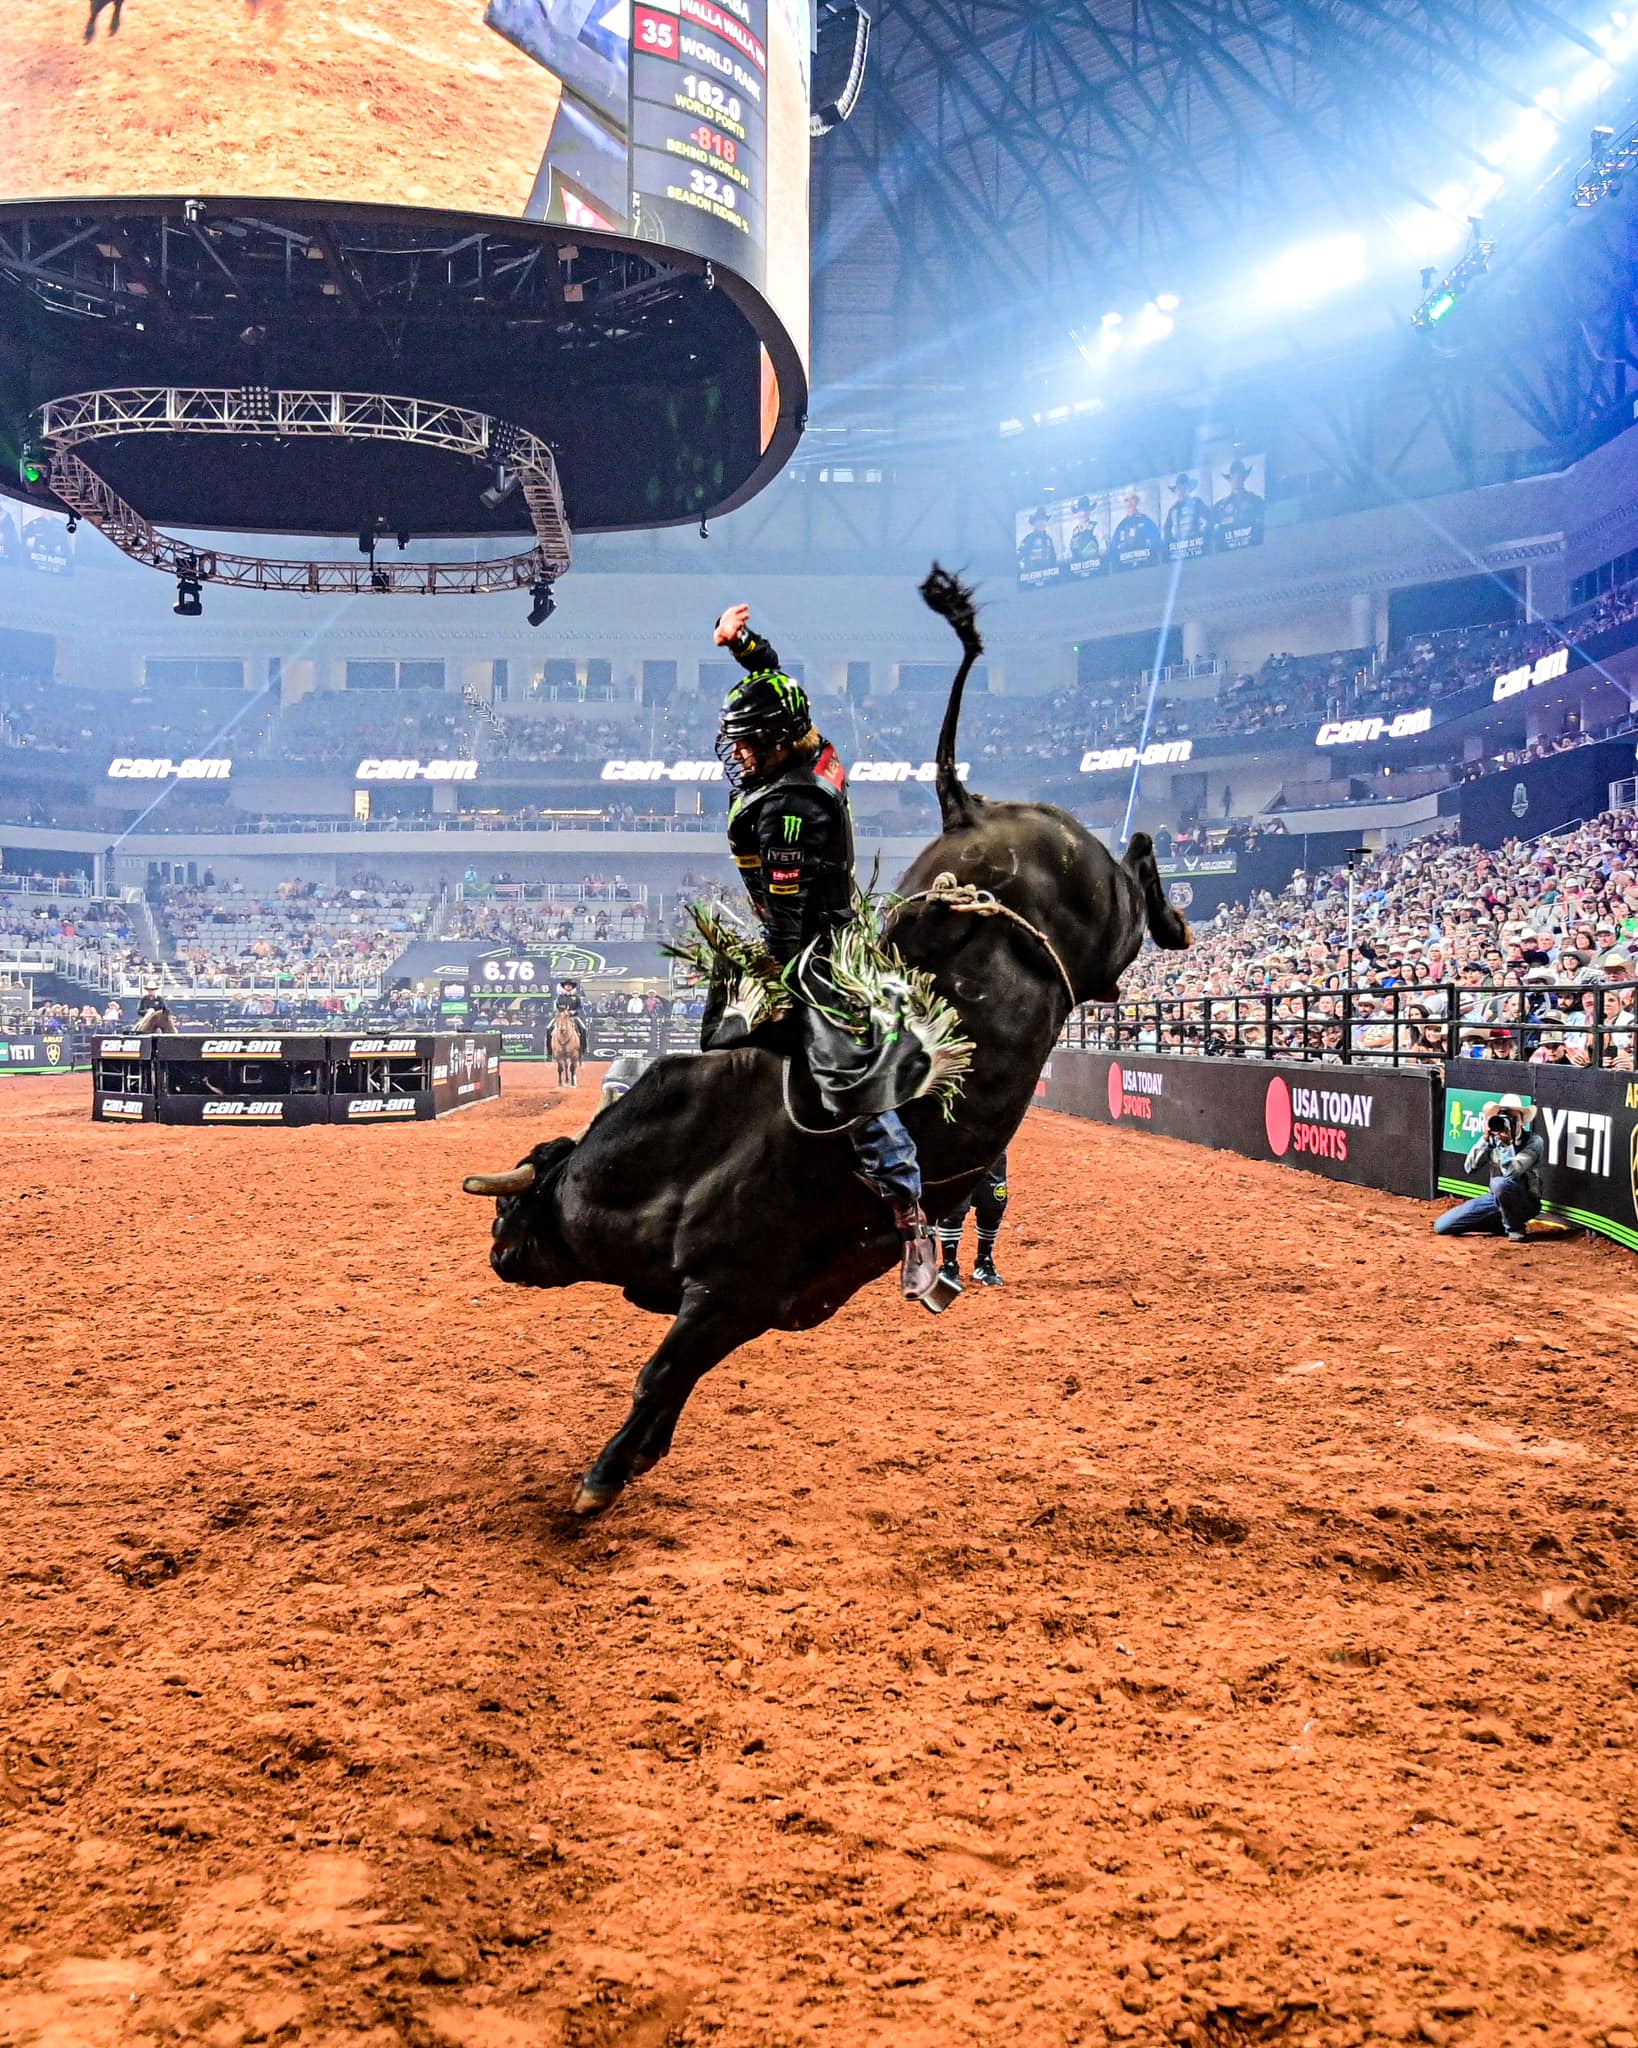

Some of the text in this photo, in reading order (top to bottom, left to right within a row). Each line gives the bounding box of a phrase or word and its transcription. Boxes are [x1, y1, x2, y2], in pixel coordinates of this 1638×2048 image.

[680, 0, 723, 29] WALLA
[641, 19, 673, 49] 35
[680, 35, 761, 102] WORLD RANK
[683, 75, 740, 121] 162.0
[675, 93, 745, 139] WORLD POINTS
[690, 126, 736, 163] -818
[666, 138, 708, 163] BEHIND
[708, 154, 740, 182] WORLD
[690, 168, 735, 209] 32.9
[667, 185, 712, 212] SEASON
[712, 203, 741, 228] RIDING
[1315, 708, 1432, 746] can-am
[107, 757, 232, 779] can-am
[355, 758, 480, 780] can-am
[1079, 739, 1192, 772] can-am
[601, 760, 725, 781] can-am
[771, 851, 801, 863] YETI
[484, 961, 535, 981] 6.76
[9, 1045, 35, 1060] YETI
[101, 1039, 141, 1052] can-am
[201, 1040, 282, 1053] can-am
[350, 1039, 416, 1053] can-am
[1122, 1069, 1163, 1096] USA TODAY
[102, 1099, 143, 1113] can-am
[202, 1101, 283, 1114] can-am
[349, 1098, 416, 1113] can-am
[1122, 1094, 1152, 1120] SPORTS
[1293, 1087, 1373, 1127] USA TODAY
[1462, 1110, 1485, 1138] ZipR
[1293, 1122, 1347, 1161] SPORTS
[1542, 1107, 1612, 1178] YETI
